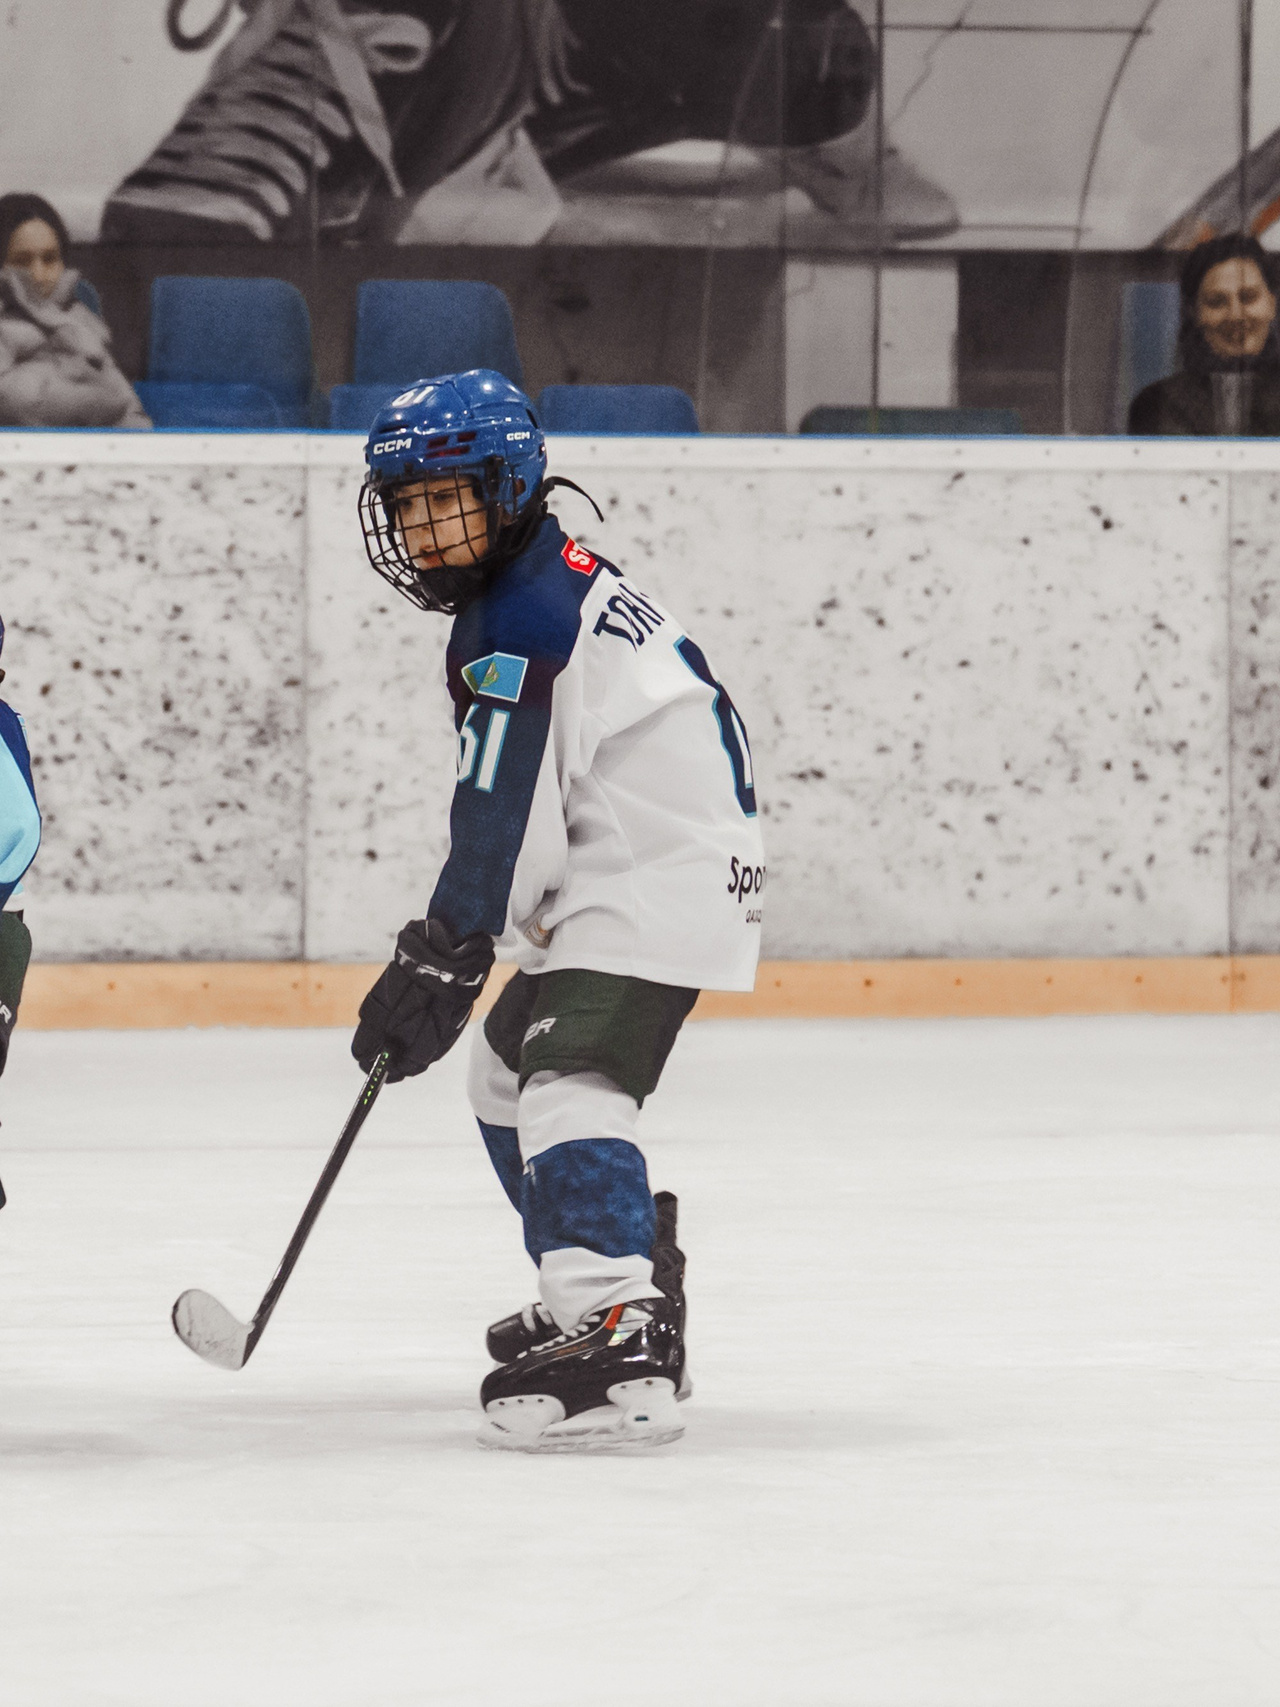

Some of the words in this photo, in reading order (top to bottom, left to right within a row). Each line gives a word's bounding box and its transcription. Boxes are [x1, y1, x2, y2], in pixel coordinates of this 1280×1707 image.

[506, 431, 530, 441] CCM
[373, 437, 412, 455] CCM
[727, 855, 766, 904] Spo
